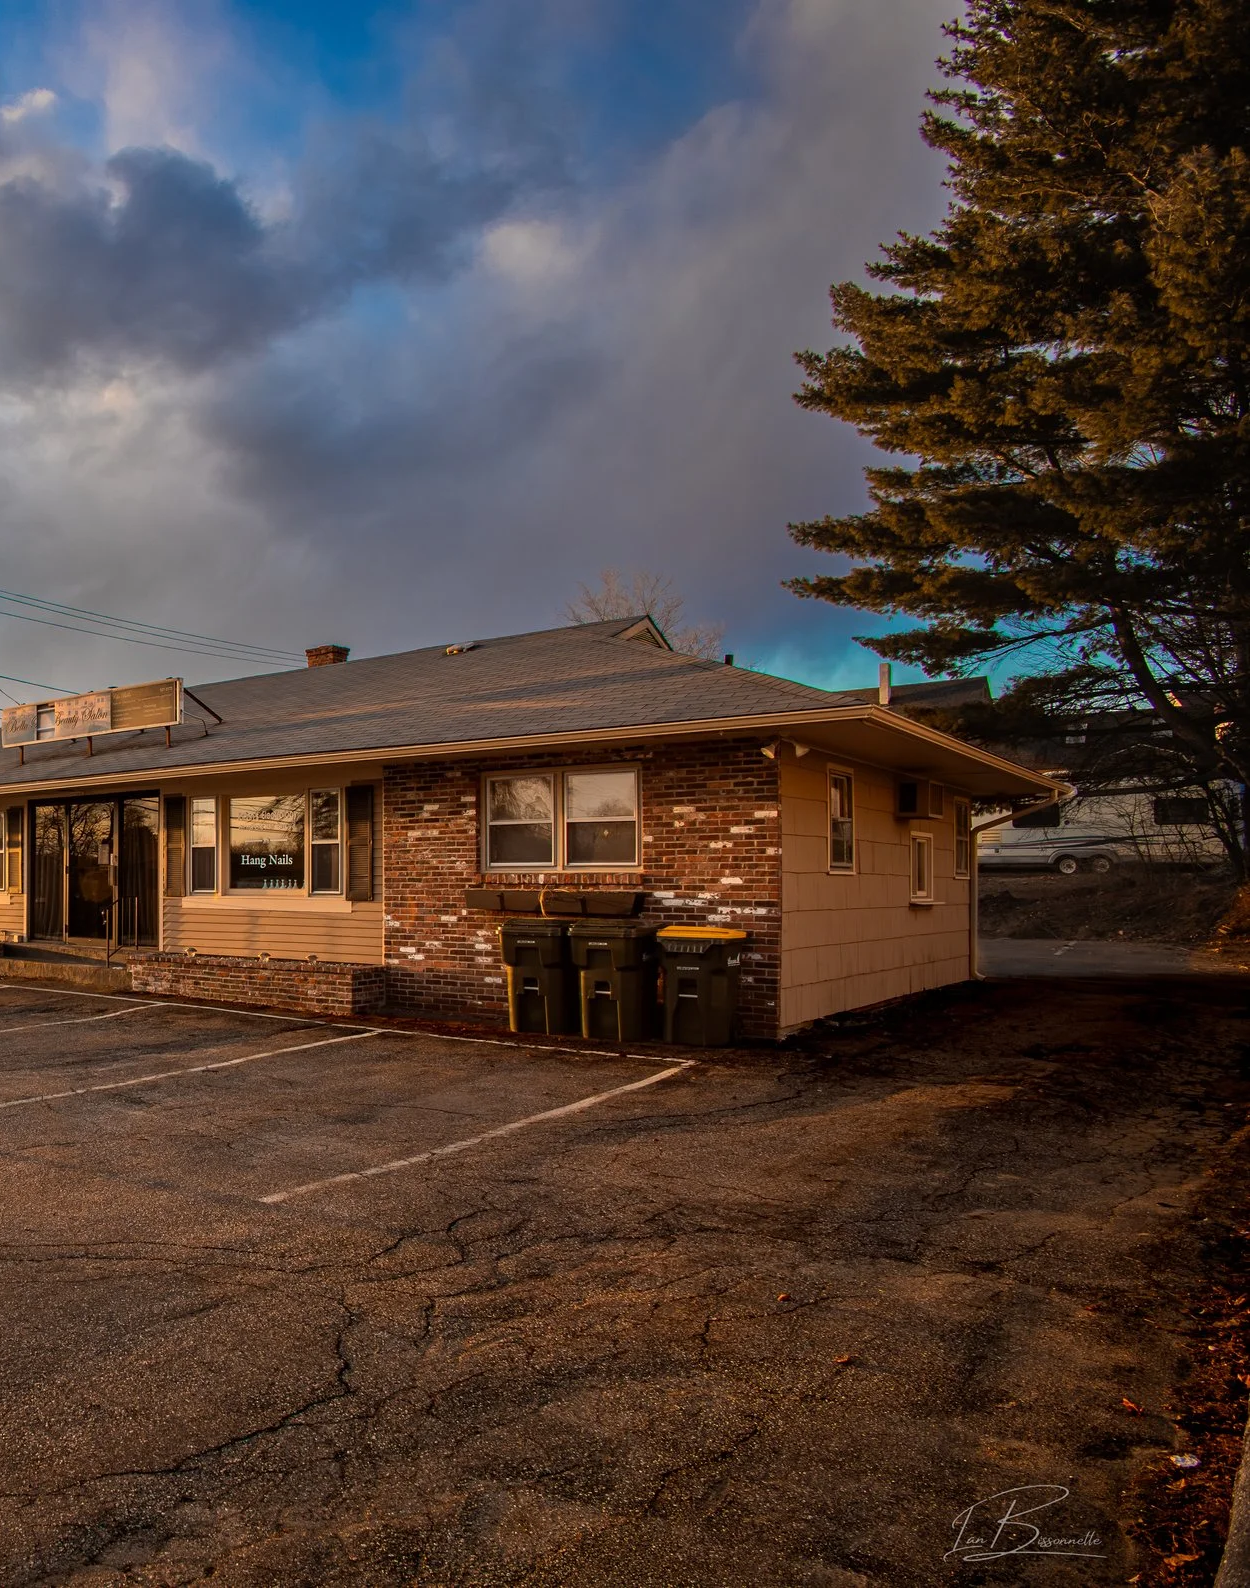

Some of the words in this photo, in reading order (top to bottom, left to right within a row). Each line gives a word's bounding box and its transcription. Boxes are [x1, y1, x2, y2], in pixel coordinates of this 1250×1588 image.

[6, 718, 29, 733] Bella
[55, 711, 79, 728] Beauty
[80, 705, 108, 722] Salon
[240, 854, 267, 869] Hang
[268, 854, 293, 865] Nails
